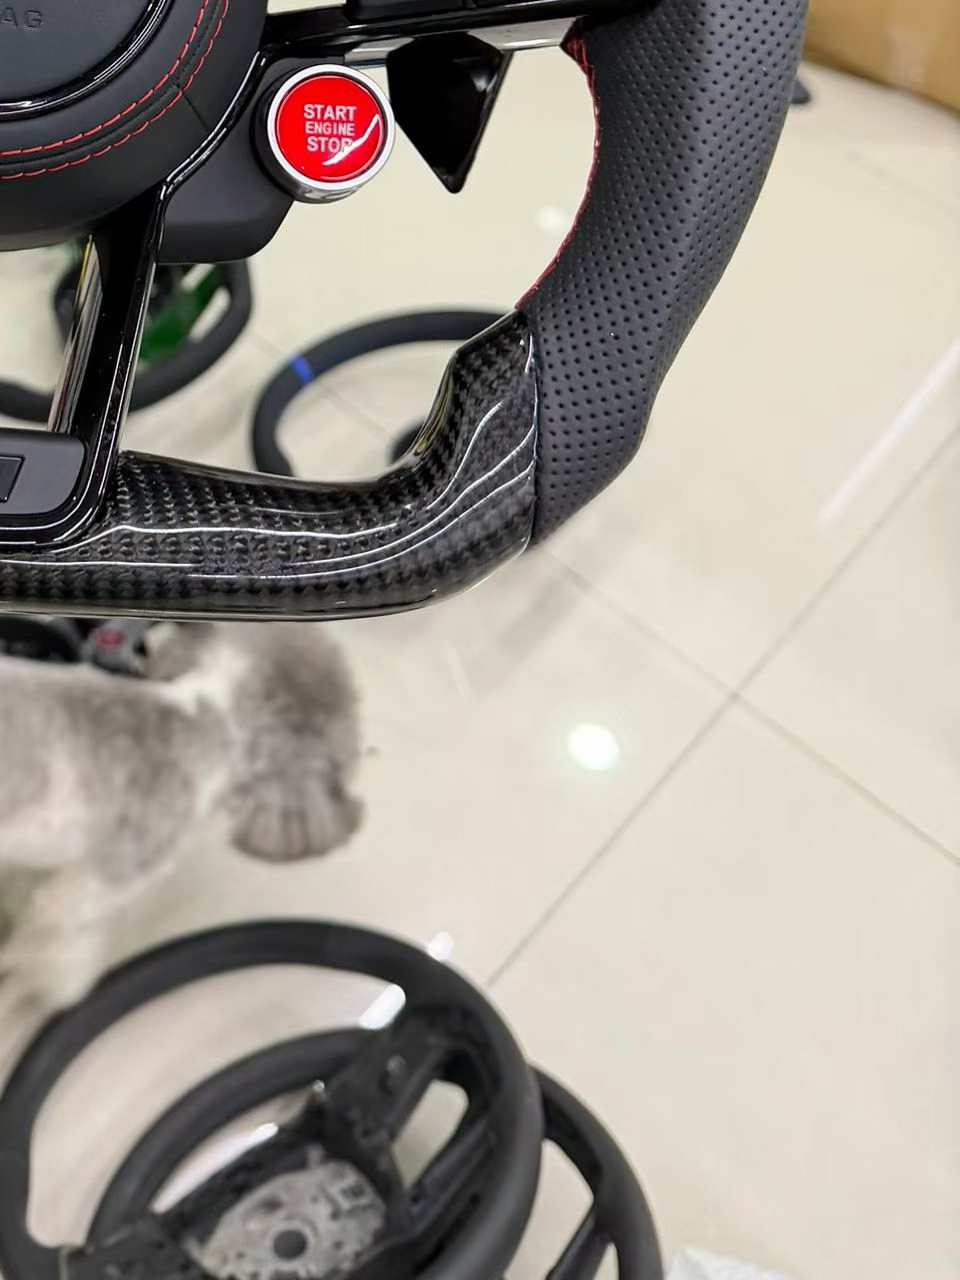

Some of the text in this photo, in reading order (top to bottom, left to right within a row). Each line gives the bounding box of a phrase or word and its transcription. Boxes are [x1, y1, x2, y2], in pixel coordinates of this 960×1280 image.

[303, 103, 358, 122] START
[305, 121, 356, 137] ENGINE
[306, 135, 354, 154] STOP
